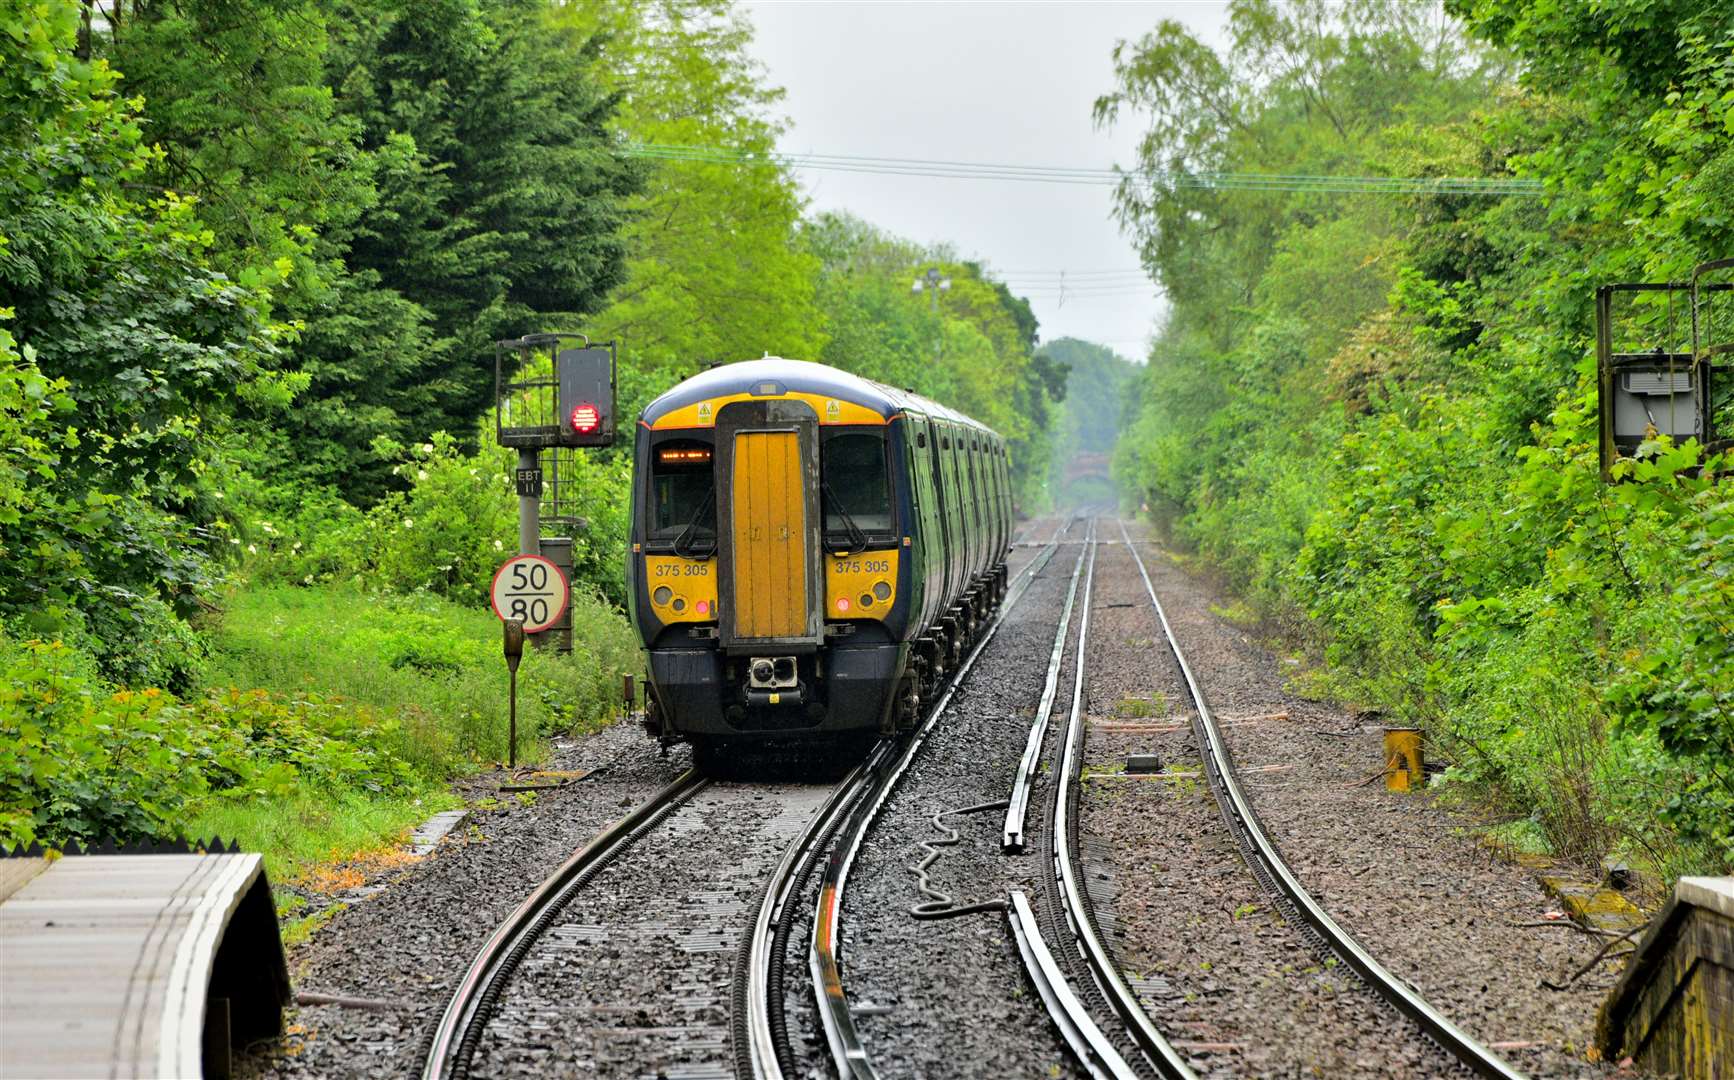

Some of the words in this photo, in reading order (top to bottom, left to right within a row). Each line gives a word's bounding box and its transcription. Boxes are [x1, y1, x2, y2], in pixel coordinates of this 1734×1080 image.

[518, 470, 540, 481] EBT
[655, 564, 680, 577] 375
[684, 564, 708, 577] 305
[835, 561, 860, 574] 375
[864, 560, 889, 573] 305
[511, 563, 548, 591] 50
[511, 598, 548, 625] 80
